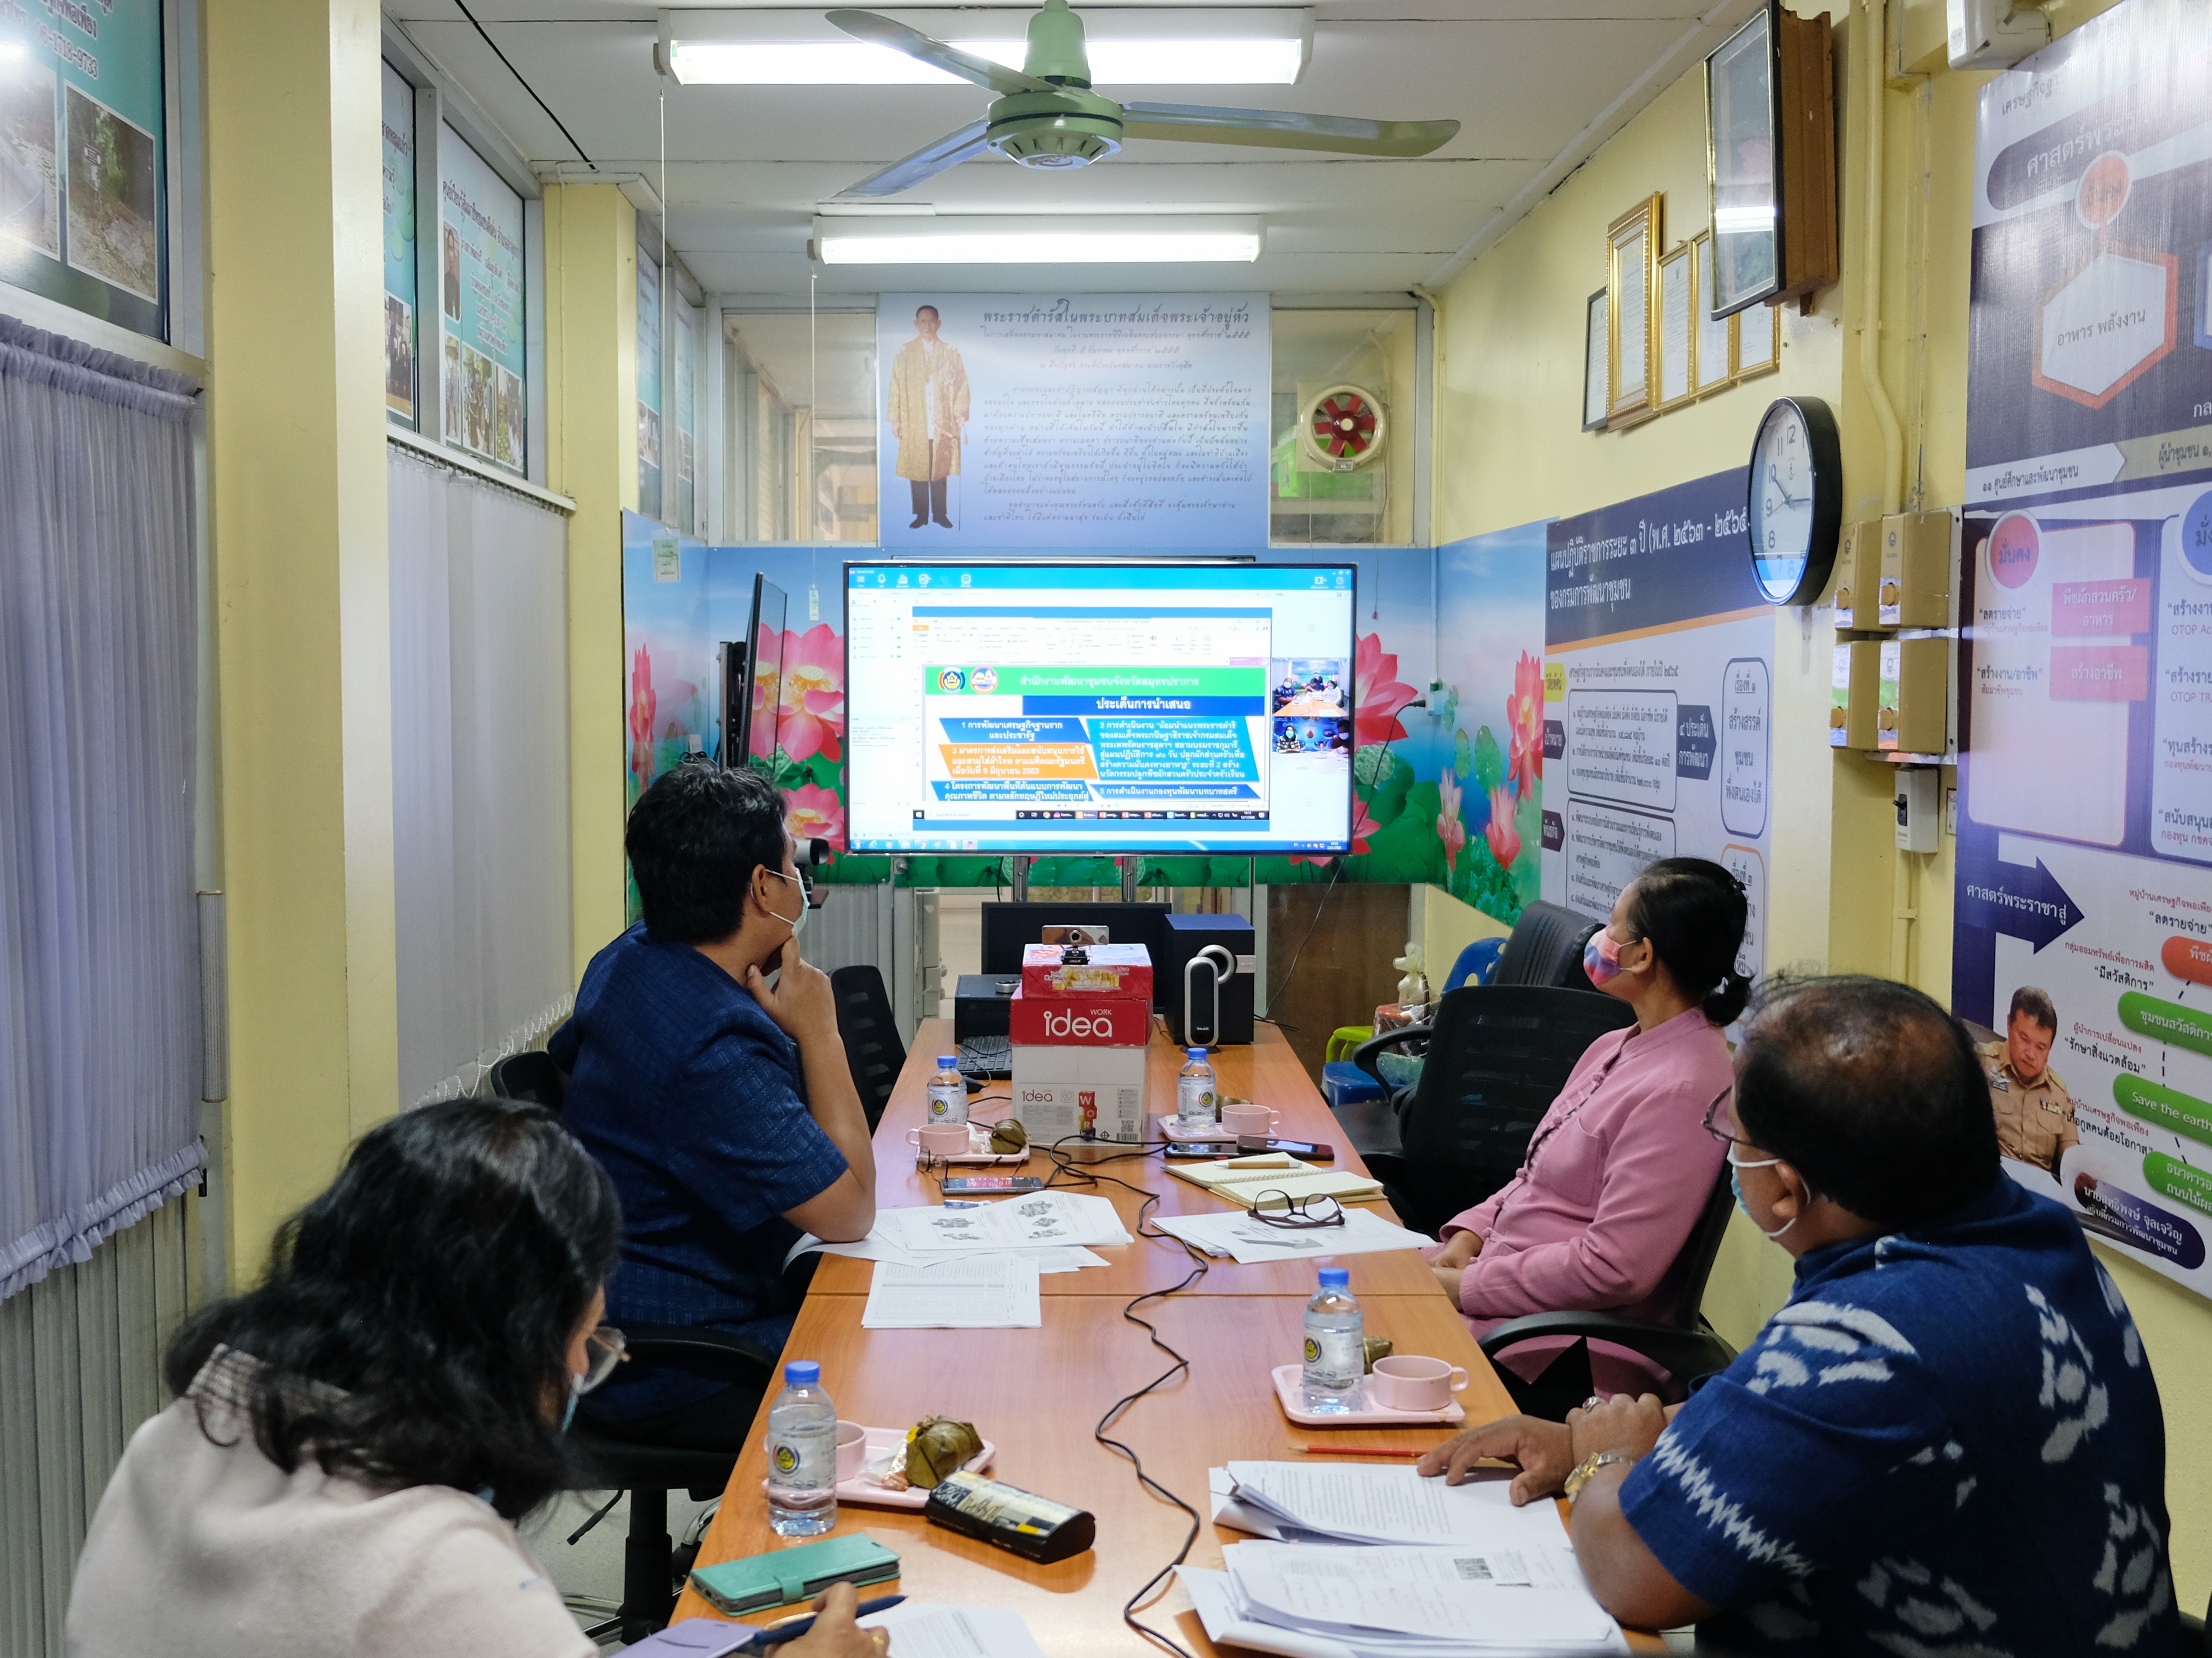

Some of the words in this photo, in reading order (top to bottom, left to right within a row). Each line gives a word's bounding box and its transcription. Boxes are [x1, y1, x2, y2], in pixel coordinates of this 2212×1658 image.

[984, 298, 1249, 330] พระราชดำรัสในพระบาทสมเด็จพระเจ้าอยู่หัว
[2057, 325, 2093, 346] อาหาร
[2097, 310, 2146, 334] พลังงาน
[1787, 424, 1796, 445] 12
[1777, 436, 1783, 456] 11
[2158, 443, 2200, 469] ผู้นำชุมชน
[1769, 464, 1776, 484] 10
[1994, 465, 2078, 496] ศูนย์ศึกษาและพัฒนาชุมชน
[1766, 498, 1772, 517] 9
[1550, 536, 1628, 578] แผนปฏิบัติราชการระยะ
[1630, 538, 1636, 555] ๓
[1639, 519, 1645, 553] ปี
[1649, 523, 1670, 553] (พ.ศ.
[1674, 519, 1703, 546] ๒๕๖๓
[1769, 529, 1775, 549] 8
[1998, 538, 2031, 564] มั่นคง
[1550, 574, 1631, 612] ของกรมการพัฒนาชุมชน
[2082, 610, 2113, 626] อาหาร
[2172, 625, 2197, 635] OTOP
[1021, 675, 1199, 688] สำนักงานพัฒนาชุมชนจังหวัดสมุทรปราการ
[1735, 670, 1749, 691] เรื่องที่
[2071, 664, 2122, 681] สร้างอาชีพ
[1096, 696, 1191, 710] ประเด็นการนำเสนอ
[2171, 691, 2196, 702] OTOP
[968, 720, 1062, 731] การพัฒนาเศรษฐกิจฐานราก
[1686, 713, 1708, 738] ประเด็น
[1729, 707, 1761, 731] สร้างสรรค์
[989, 731, 1035, 741] และประชารัฐ
[1100, 741, 1172, 750] พระเทพรัตนราชสุดาฯ
[1175, 740, 1237, 750] สยามบรมราชกุมารี
[953, 756, 1012, 764] และสวมใส่ผ้าไทย
[1015, 756, 1085, 767] ตามมติคณะรัฐมนตรี
[1100, 750, 1153, 761] สู่แผนปฏิบัติการ
[1192, 759, 1214, 768] ระยะที่
[1679, 744, 1708, 768] การพัฒนา
[1735, 751, 1753, 773] ชุมชน
[953, 765, 981, 774] เมื่อวันที่
[990, 766, 1020, 777] มิถุนายน
[945, 791, 987, 801] คุณภาพชีวิต
[1107, 787, 1237, 797] การดำเนินงานกองทุนพัฒนาบทบาทสตรี
[1726, 774, 1762, 804] พึ่งตนเองได้
[2161, 830, 2188, 845] กองทุน
[1967, 884, 2067, 926] ศาสตร์พระราชาสู่
[2129, 889, 2212, 913] หมู่บ้านเศรษฐกิจพอเพีย
[2065, 941, 2155, 972] กลุ่มออมทรัพย์เพื่อการผลิต
[2094, 965, 2154, 991] “มีสวัสดิการ”
[1043, 1008, 1112, 1037] idea
[2073, 1021, 2142, 1053] ผู้นำการเปลี่ยนแปลง
[2064, 1036, 2146, 1073] “รักษาสิ่งแวดล้อม”
[1022, 1090, 1053, 1102] idea
[1079, 1096, 1091, 1105] W
[2066, 1096, 2149, 1137] หมู่บ้านเศรษฐกิจพอเพียง
[2132, 1092, 2157, 1110] Save
[2161, 1104, 2180, 1119] the
[2183, 1113, 2212, 1132] earth
[2084, 1186, 2140, 1221] นายสุทธิพงษ์
[2144, 1215, 2183, 1245] จุลเจริญ
[2087, 1203, 2178, 1256] อธิบดีกรมการพัฒนาชุมชน
